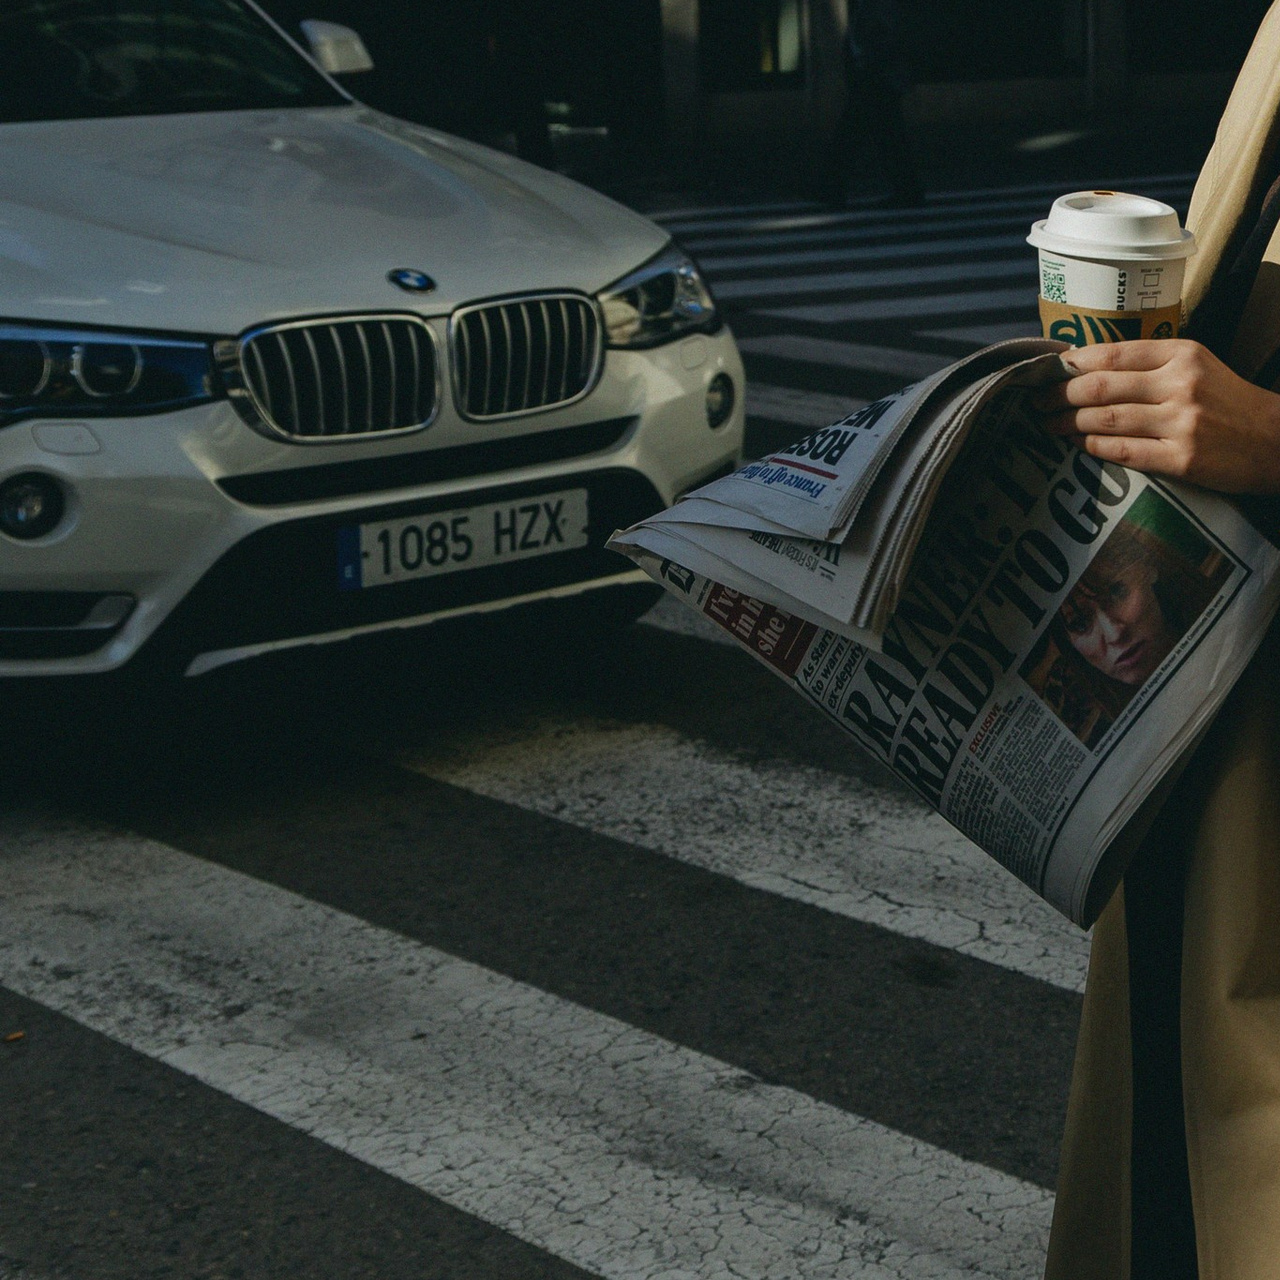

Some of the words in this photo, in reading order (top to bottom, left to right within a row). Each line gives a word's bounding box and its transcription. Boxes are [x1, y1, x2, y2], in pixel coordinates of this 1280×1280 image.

[1116, 271, 1127, 311] BUCKS
[764, 467, 787, 484] off
[783, 475, 826, 498] France
[378, 517, 473, 575] 1085
[494, 500, 565, 555] HZX
[780, 543, 806, 566] Friday!
[806, 555, 819, 571] It's
[708, 583, 740, 619] I've
[731, 611, 756, 638] in
[757, 613, 786, 655] she
[846, 526, 1014, 757] RAYNER:
[898, 607, 1018, 808] READY
[986, 529, 1071, 629] TO
[1047, 448, 1130, 543] GO
[802, 664, 815, 683] As
[811, 678, 824, 696] to
[822, 643, 845, 678] warn
[827, 643, 864, 709] ex-deputy
[968, 702, 1001, 753] EXCLUSIVE
